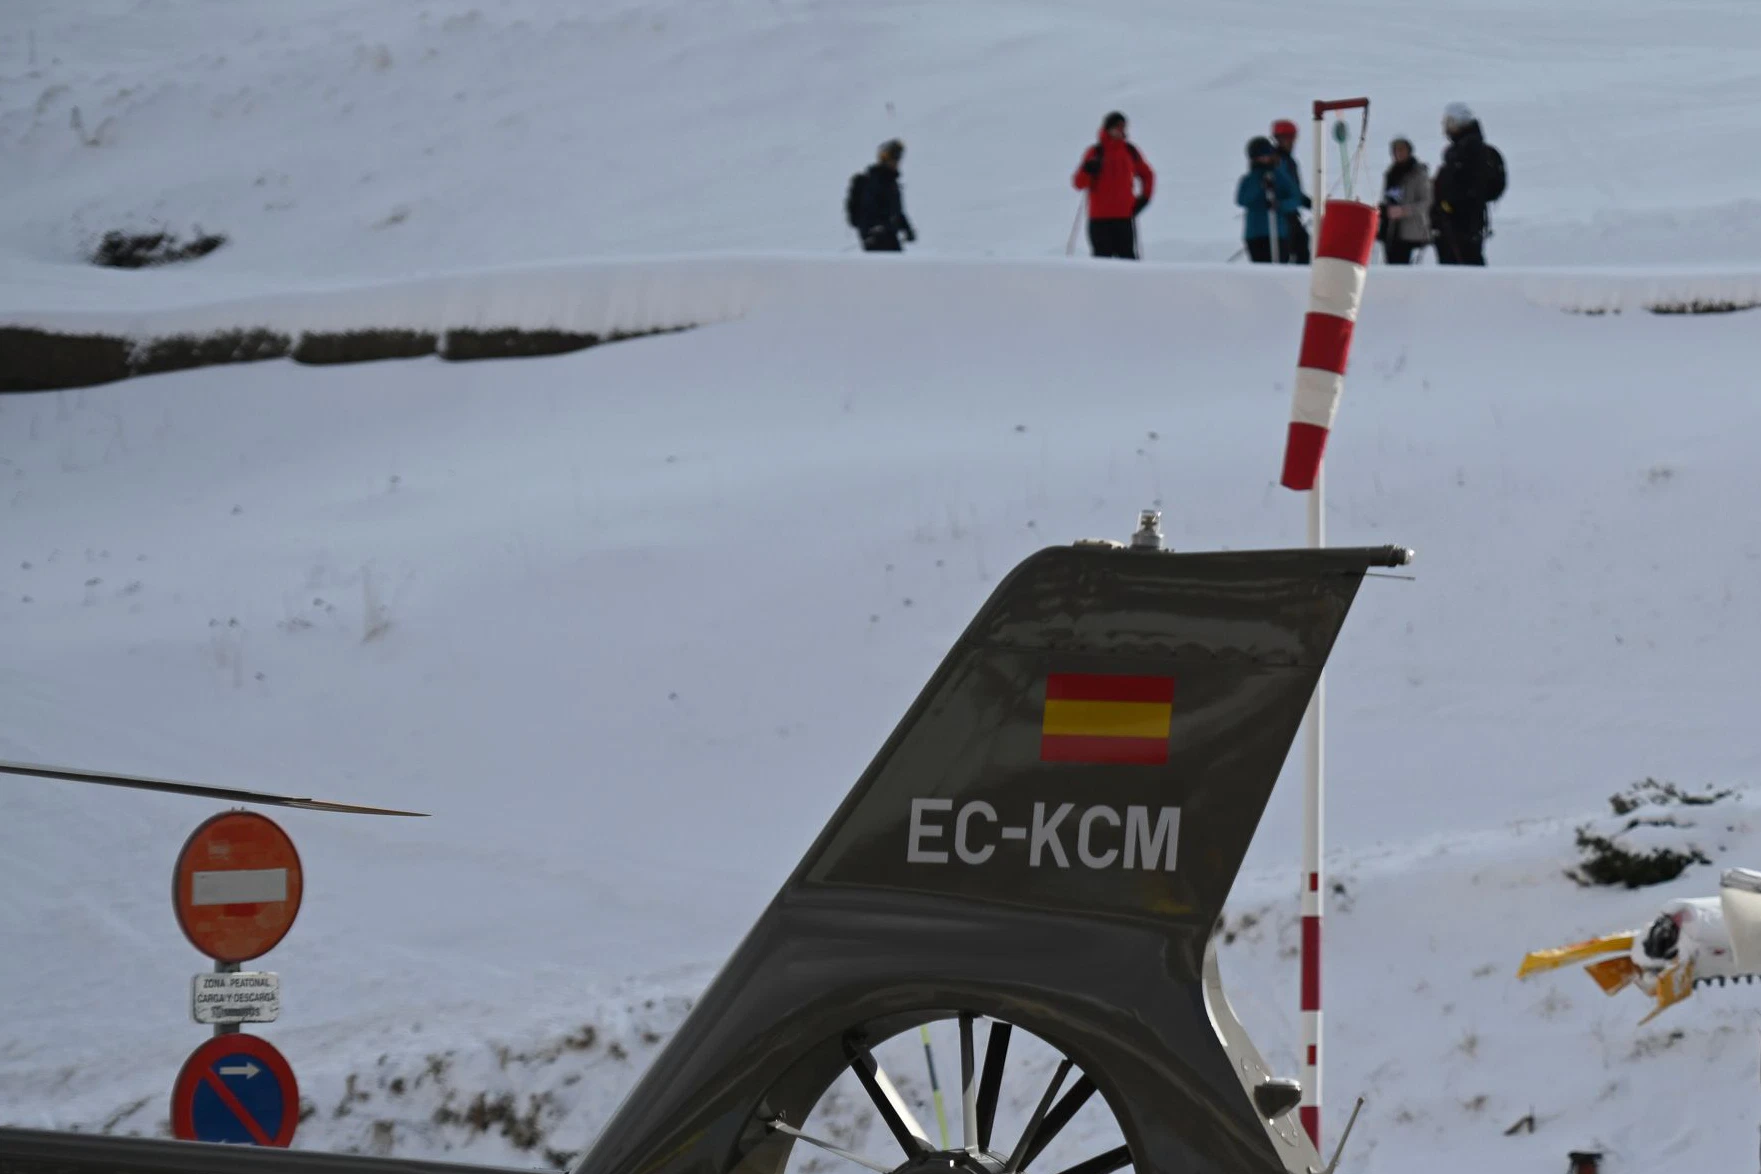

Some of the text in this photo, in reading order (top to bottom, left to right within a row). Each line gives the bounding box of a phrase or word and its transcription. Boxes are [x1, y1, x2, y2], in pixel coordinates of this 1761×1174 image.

[907, 797, 1182, 872] EC-KCM
[203, 978, 270, 988] ZONA PEATONAL
[197, 991, 275, 1003] CARGA Y DESCARGA
